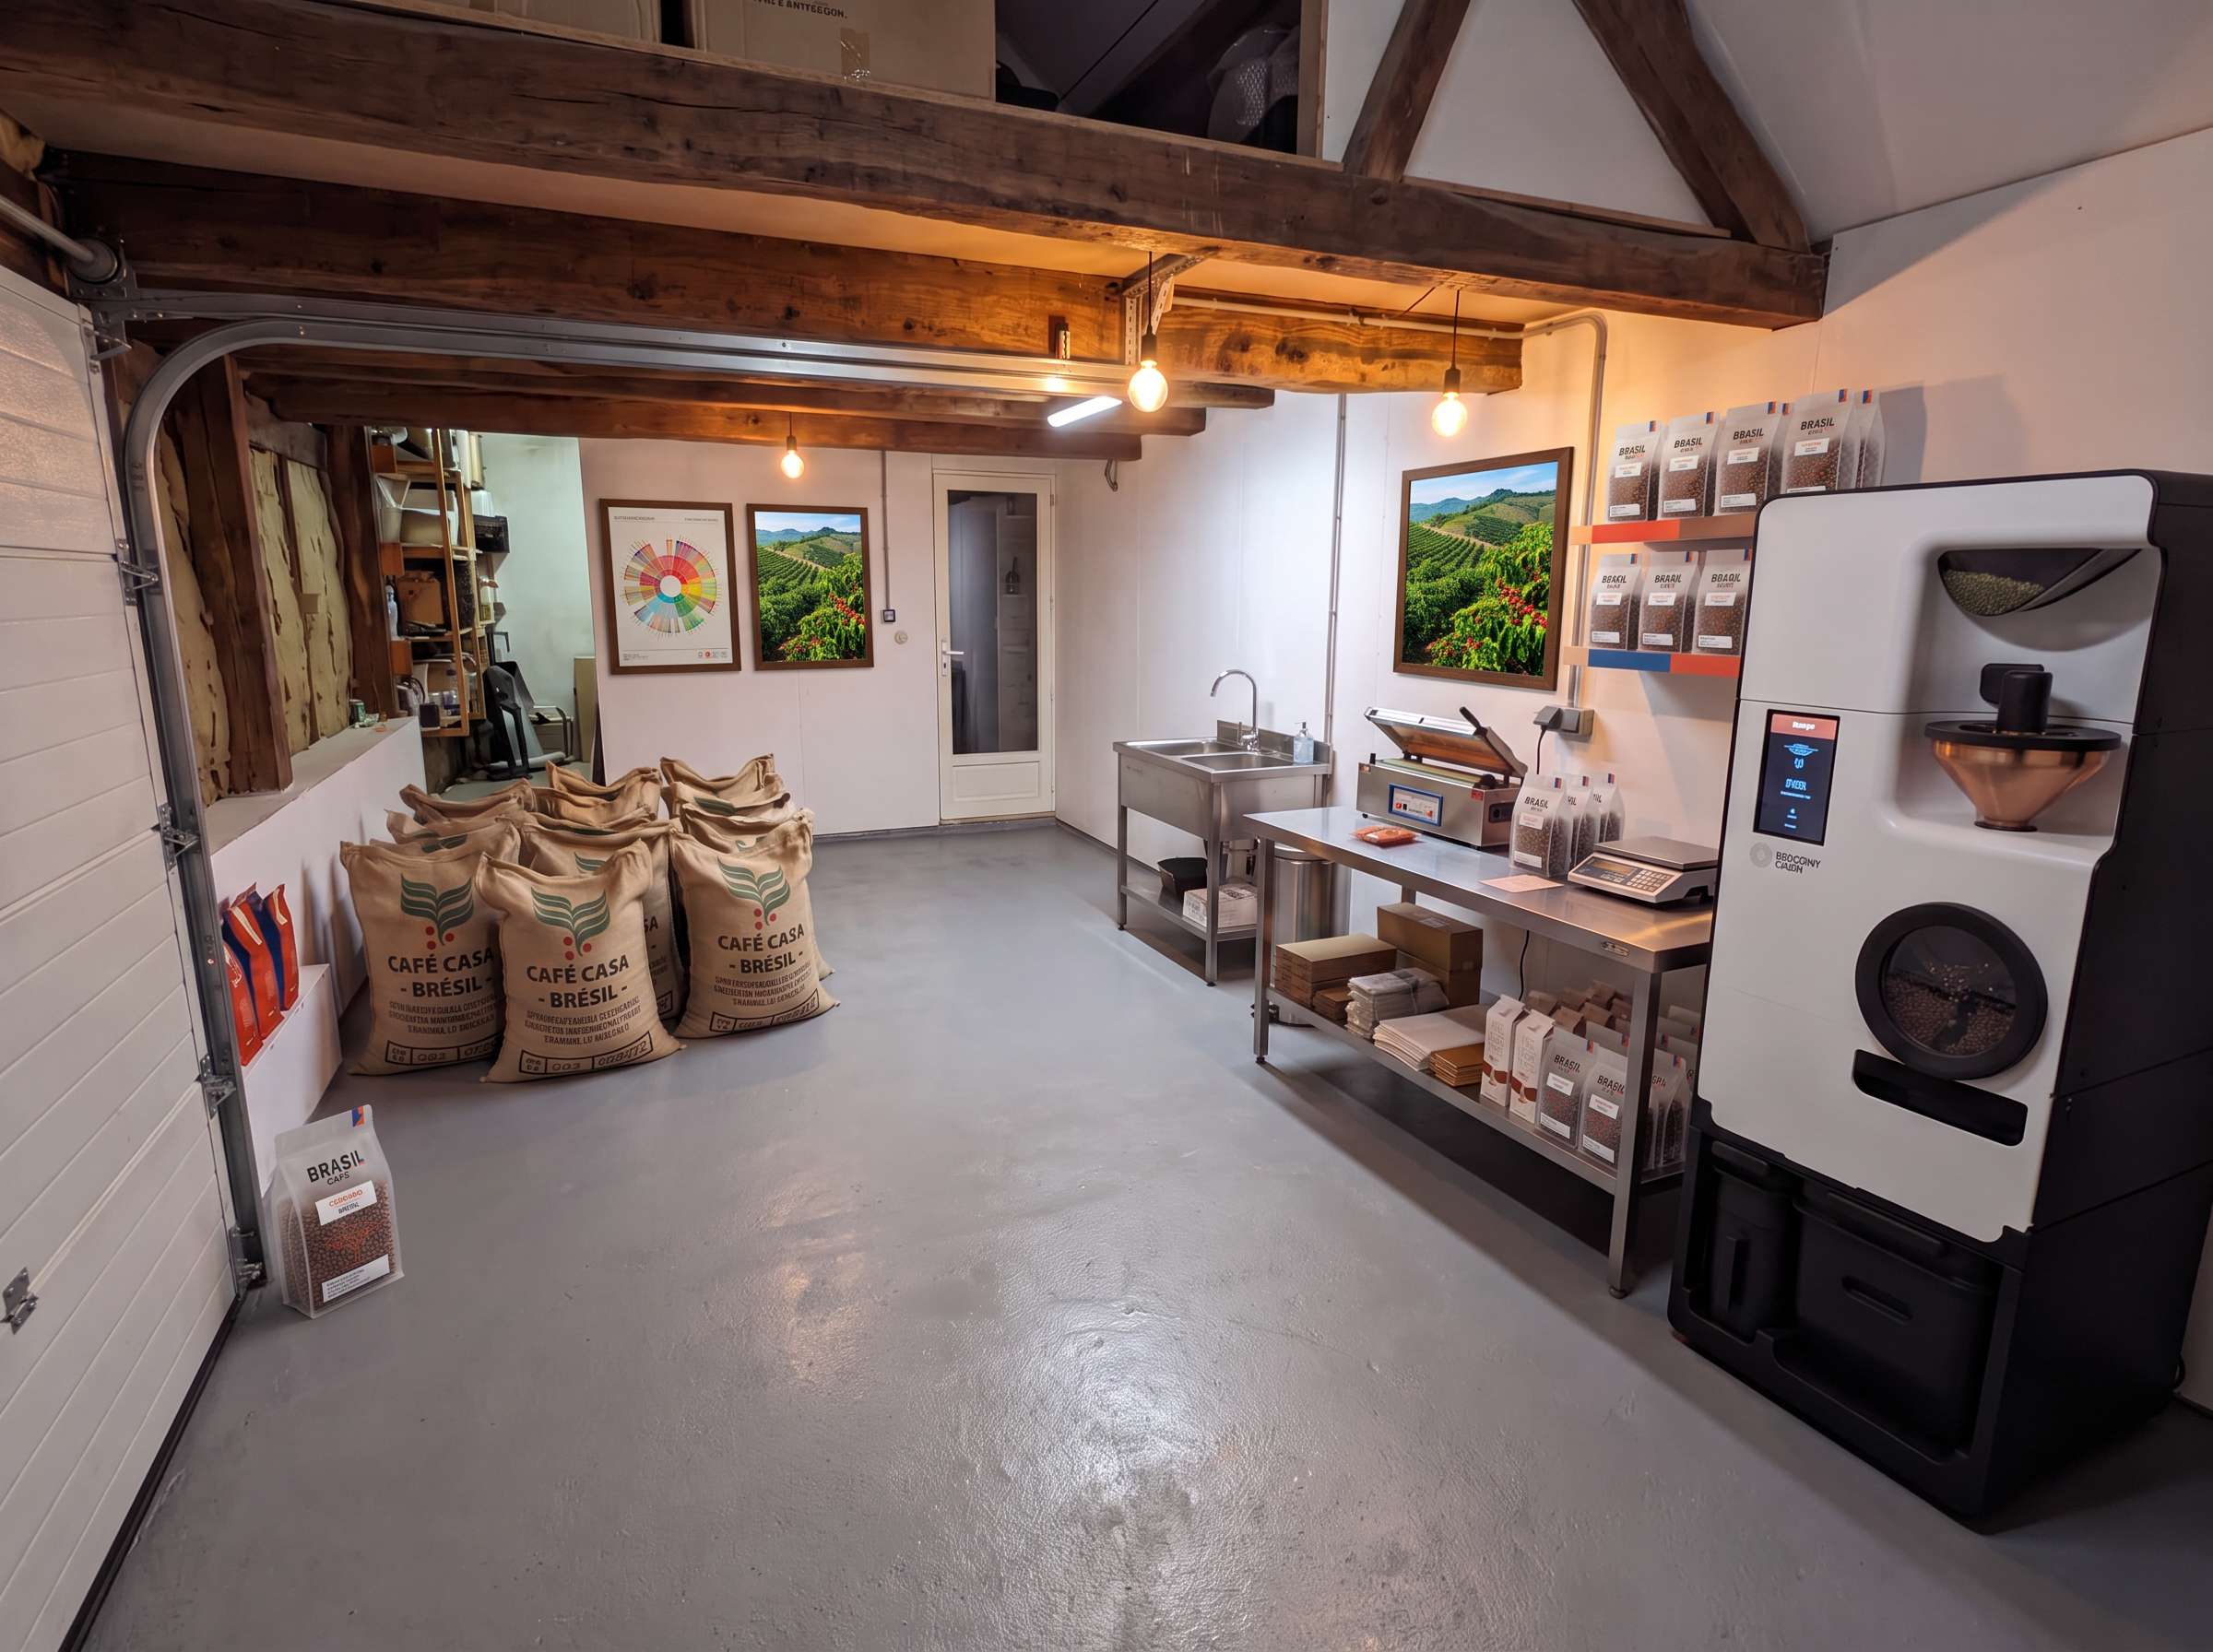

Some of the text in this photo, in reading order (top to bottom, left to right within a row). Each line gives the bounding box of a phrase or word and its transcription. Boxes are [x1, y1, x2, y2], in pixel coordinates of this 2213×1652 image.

[1800, 418, 1835, 431] BRASIL
[718, 923, 805, 952] CAFÉ CASA
[388, 947, 495, 974] CAFÉ CASA
[527, 954, 630, 985] CAFÉ CASA
[740, 951, 797, 974] BRÉSIL
[412, 977, 483, 997] BRÉSIL
[550, 984, 619, 1009] BRÉSIL
[306, 1150, 365, 1183] BRASIL
